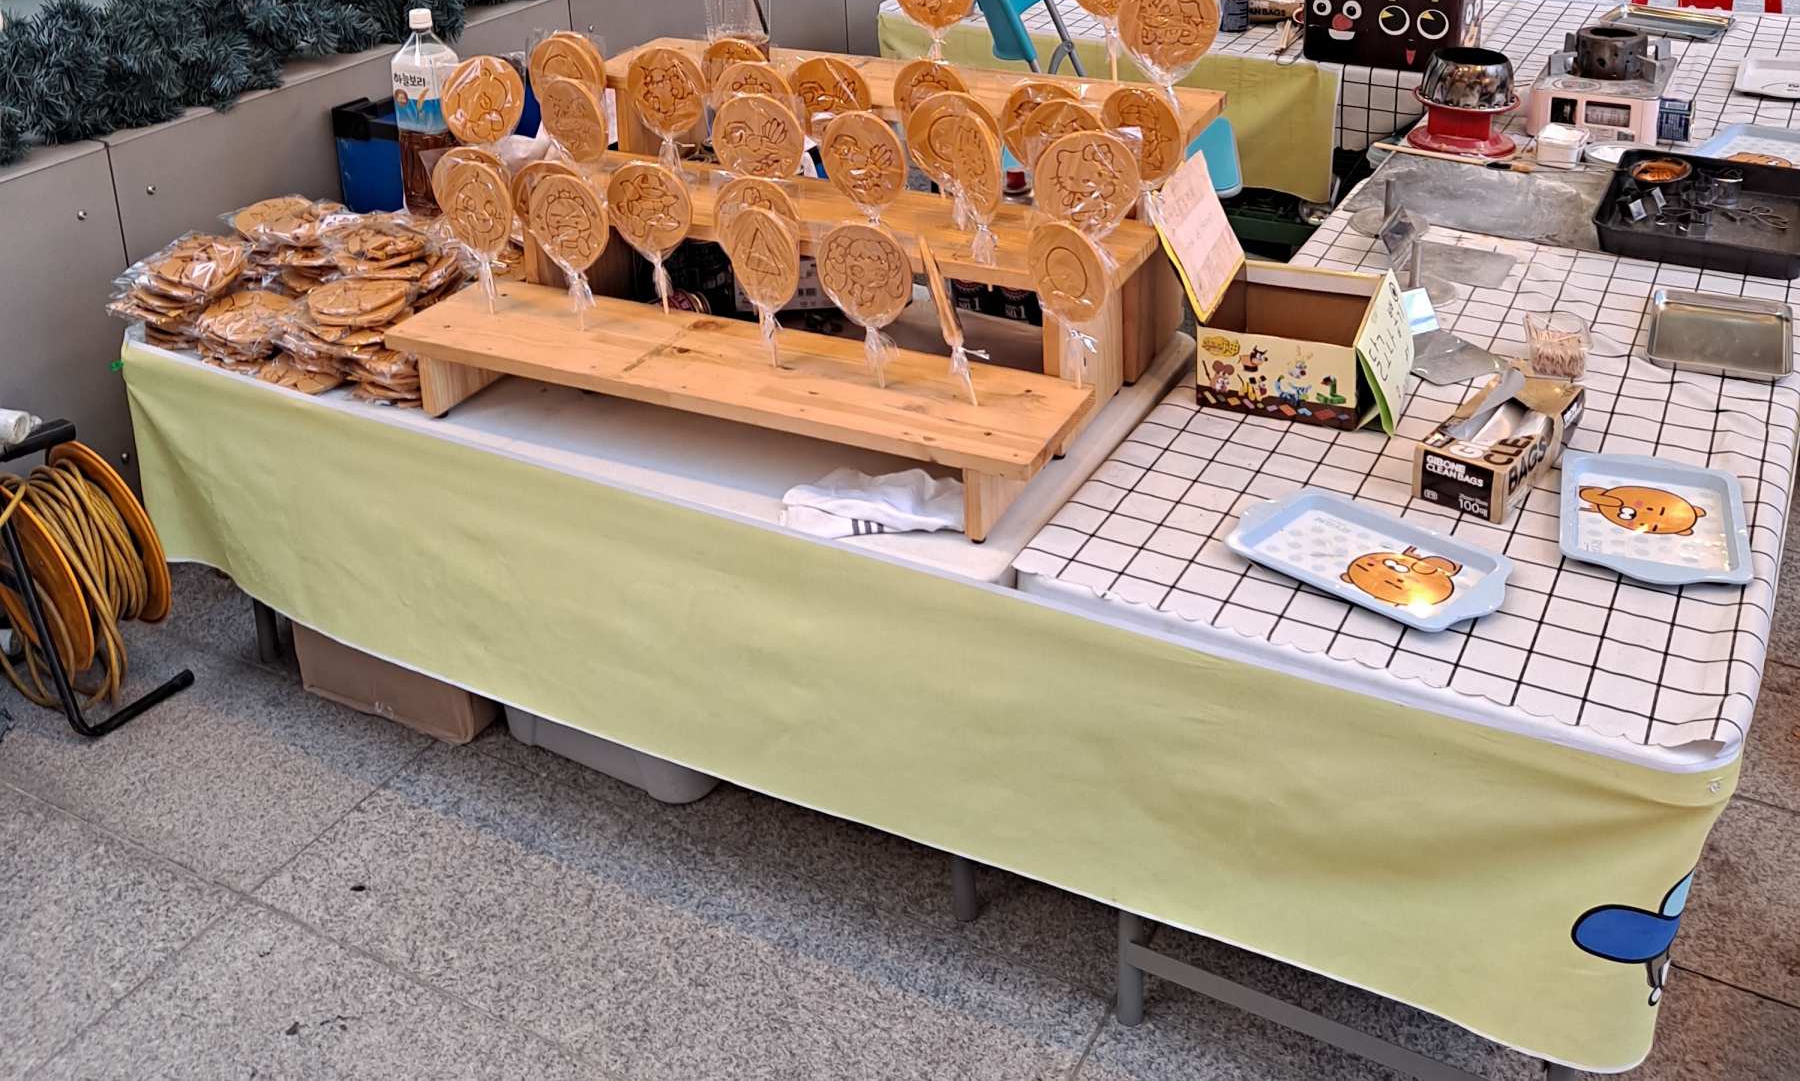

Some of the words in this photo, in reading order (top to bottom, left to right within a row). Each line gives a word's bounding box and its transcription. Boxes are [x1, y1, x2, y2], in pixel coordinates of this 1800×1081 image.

[394, 72, 426, 87] 하늘보리
[1426, 455, 1466, 474] GIBONE
[1426, 463, 1458, 479] CLEAN
[1457, 472, 1484, 488] BAGS
[1508, 436, 1548, 496] BAGS
